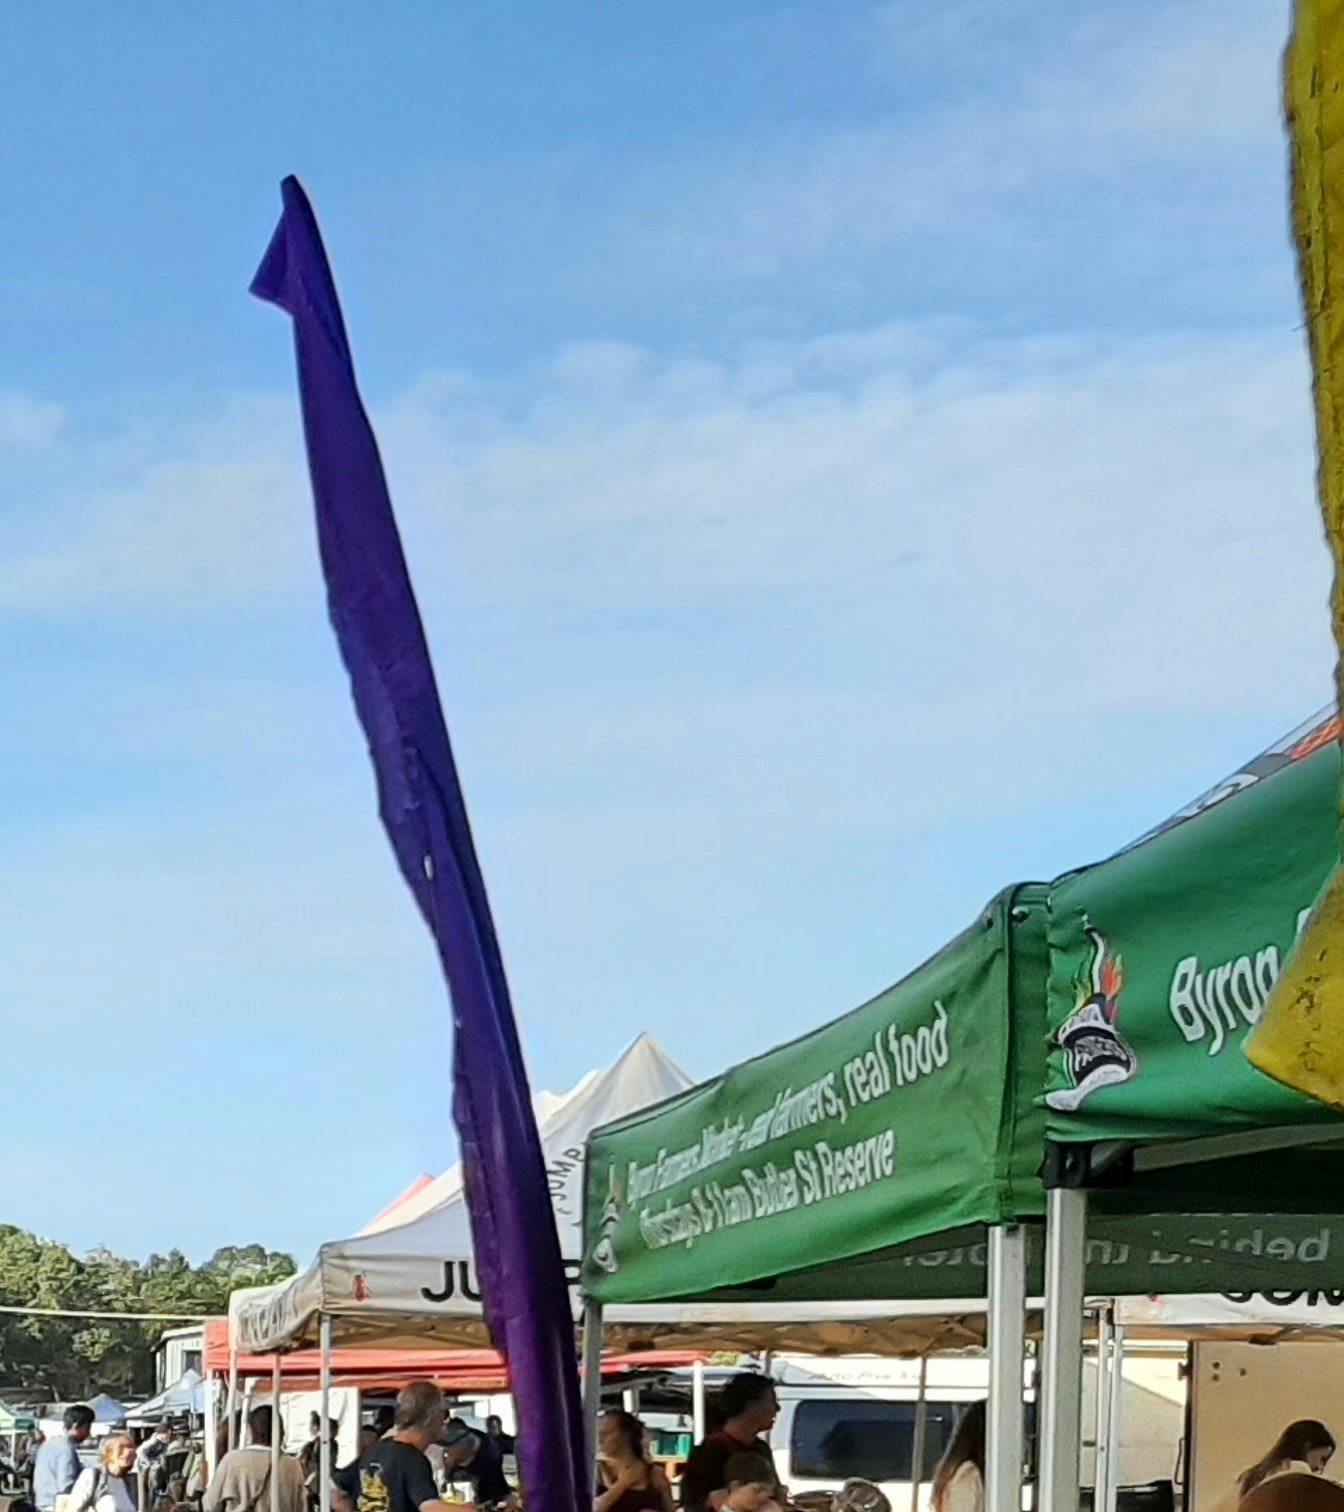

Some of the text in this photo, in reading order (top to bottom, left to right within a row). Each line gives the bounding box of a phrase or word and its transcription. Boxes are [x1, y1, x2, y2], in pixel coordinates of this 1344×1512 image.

[842, 1030, 893, 1106] real
[888, 999, 950, 1087] food
[1170, 945, 1280, 1056] Byron
[794, 1150, 823, 1205] St
[815, 1129, 895, 1198] Reserve
